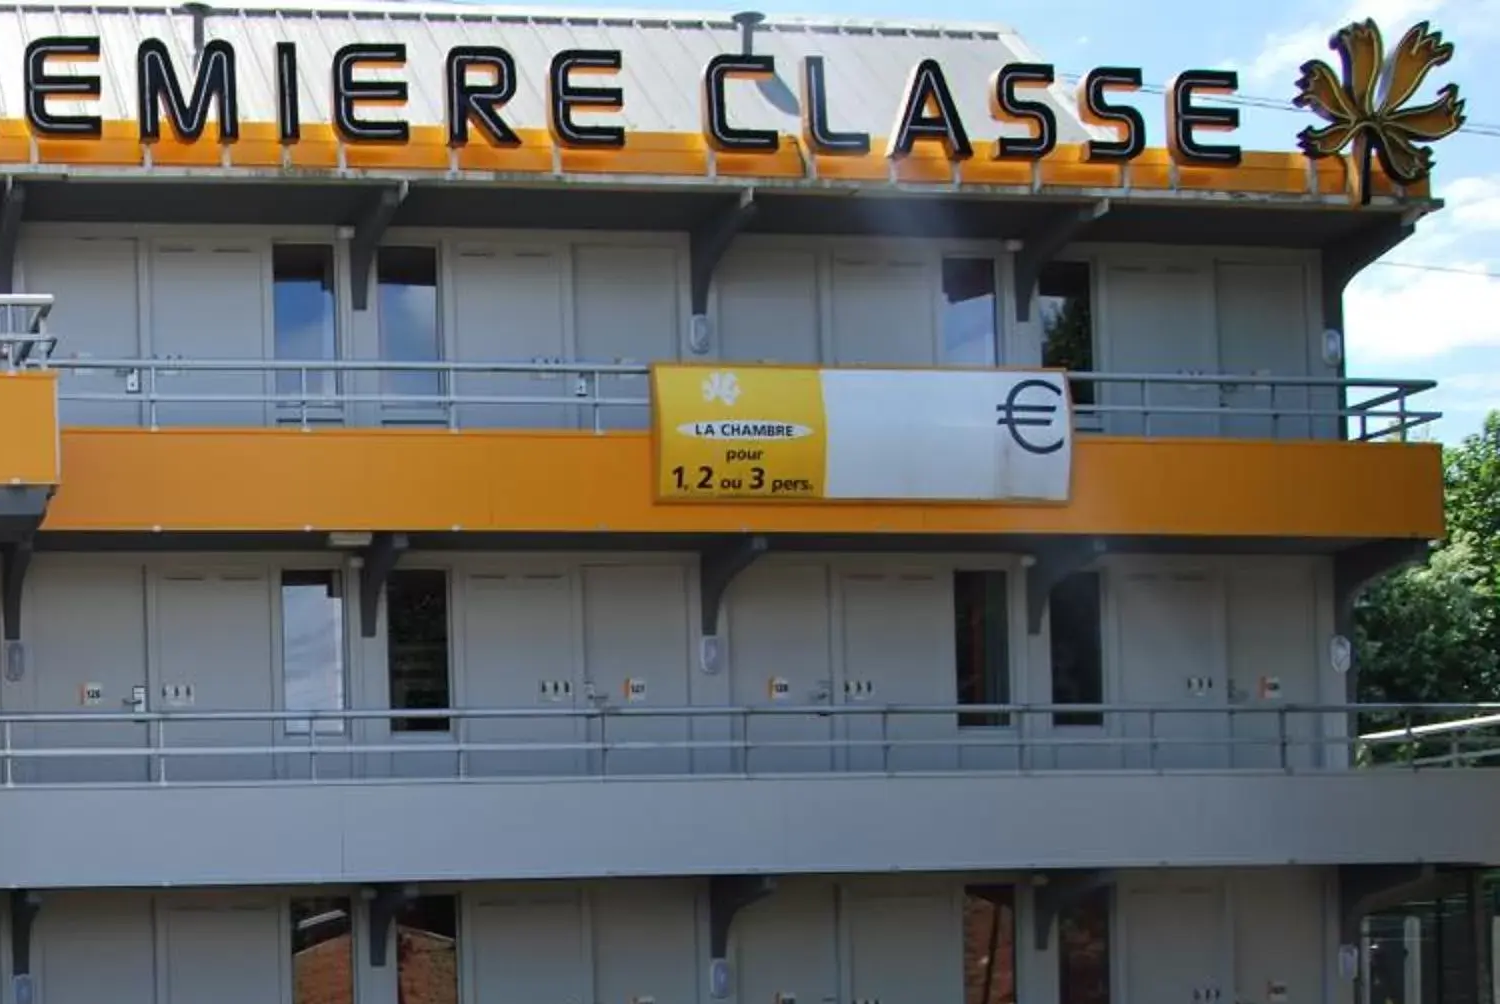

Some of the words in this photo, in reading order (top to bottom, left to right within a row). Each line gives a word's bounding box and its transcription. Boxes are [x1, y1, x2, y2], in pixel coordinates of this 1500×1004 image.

[702, 54, 1243, 167] CLASSE
[694, 423, 716, 437] LA
[720, 423, 794, 438] CHAMBRE
[725, 448, 764, 463] pour
[696, 465, 714, 490] 2
[719, 477, 743, 490] ou
[749, 467, 766, 490] 3
[771, 478, 815, 493] pers.
